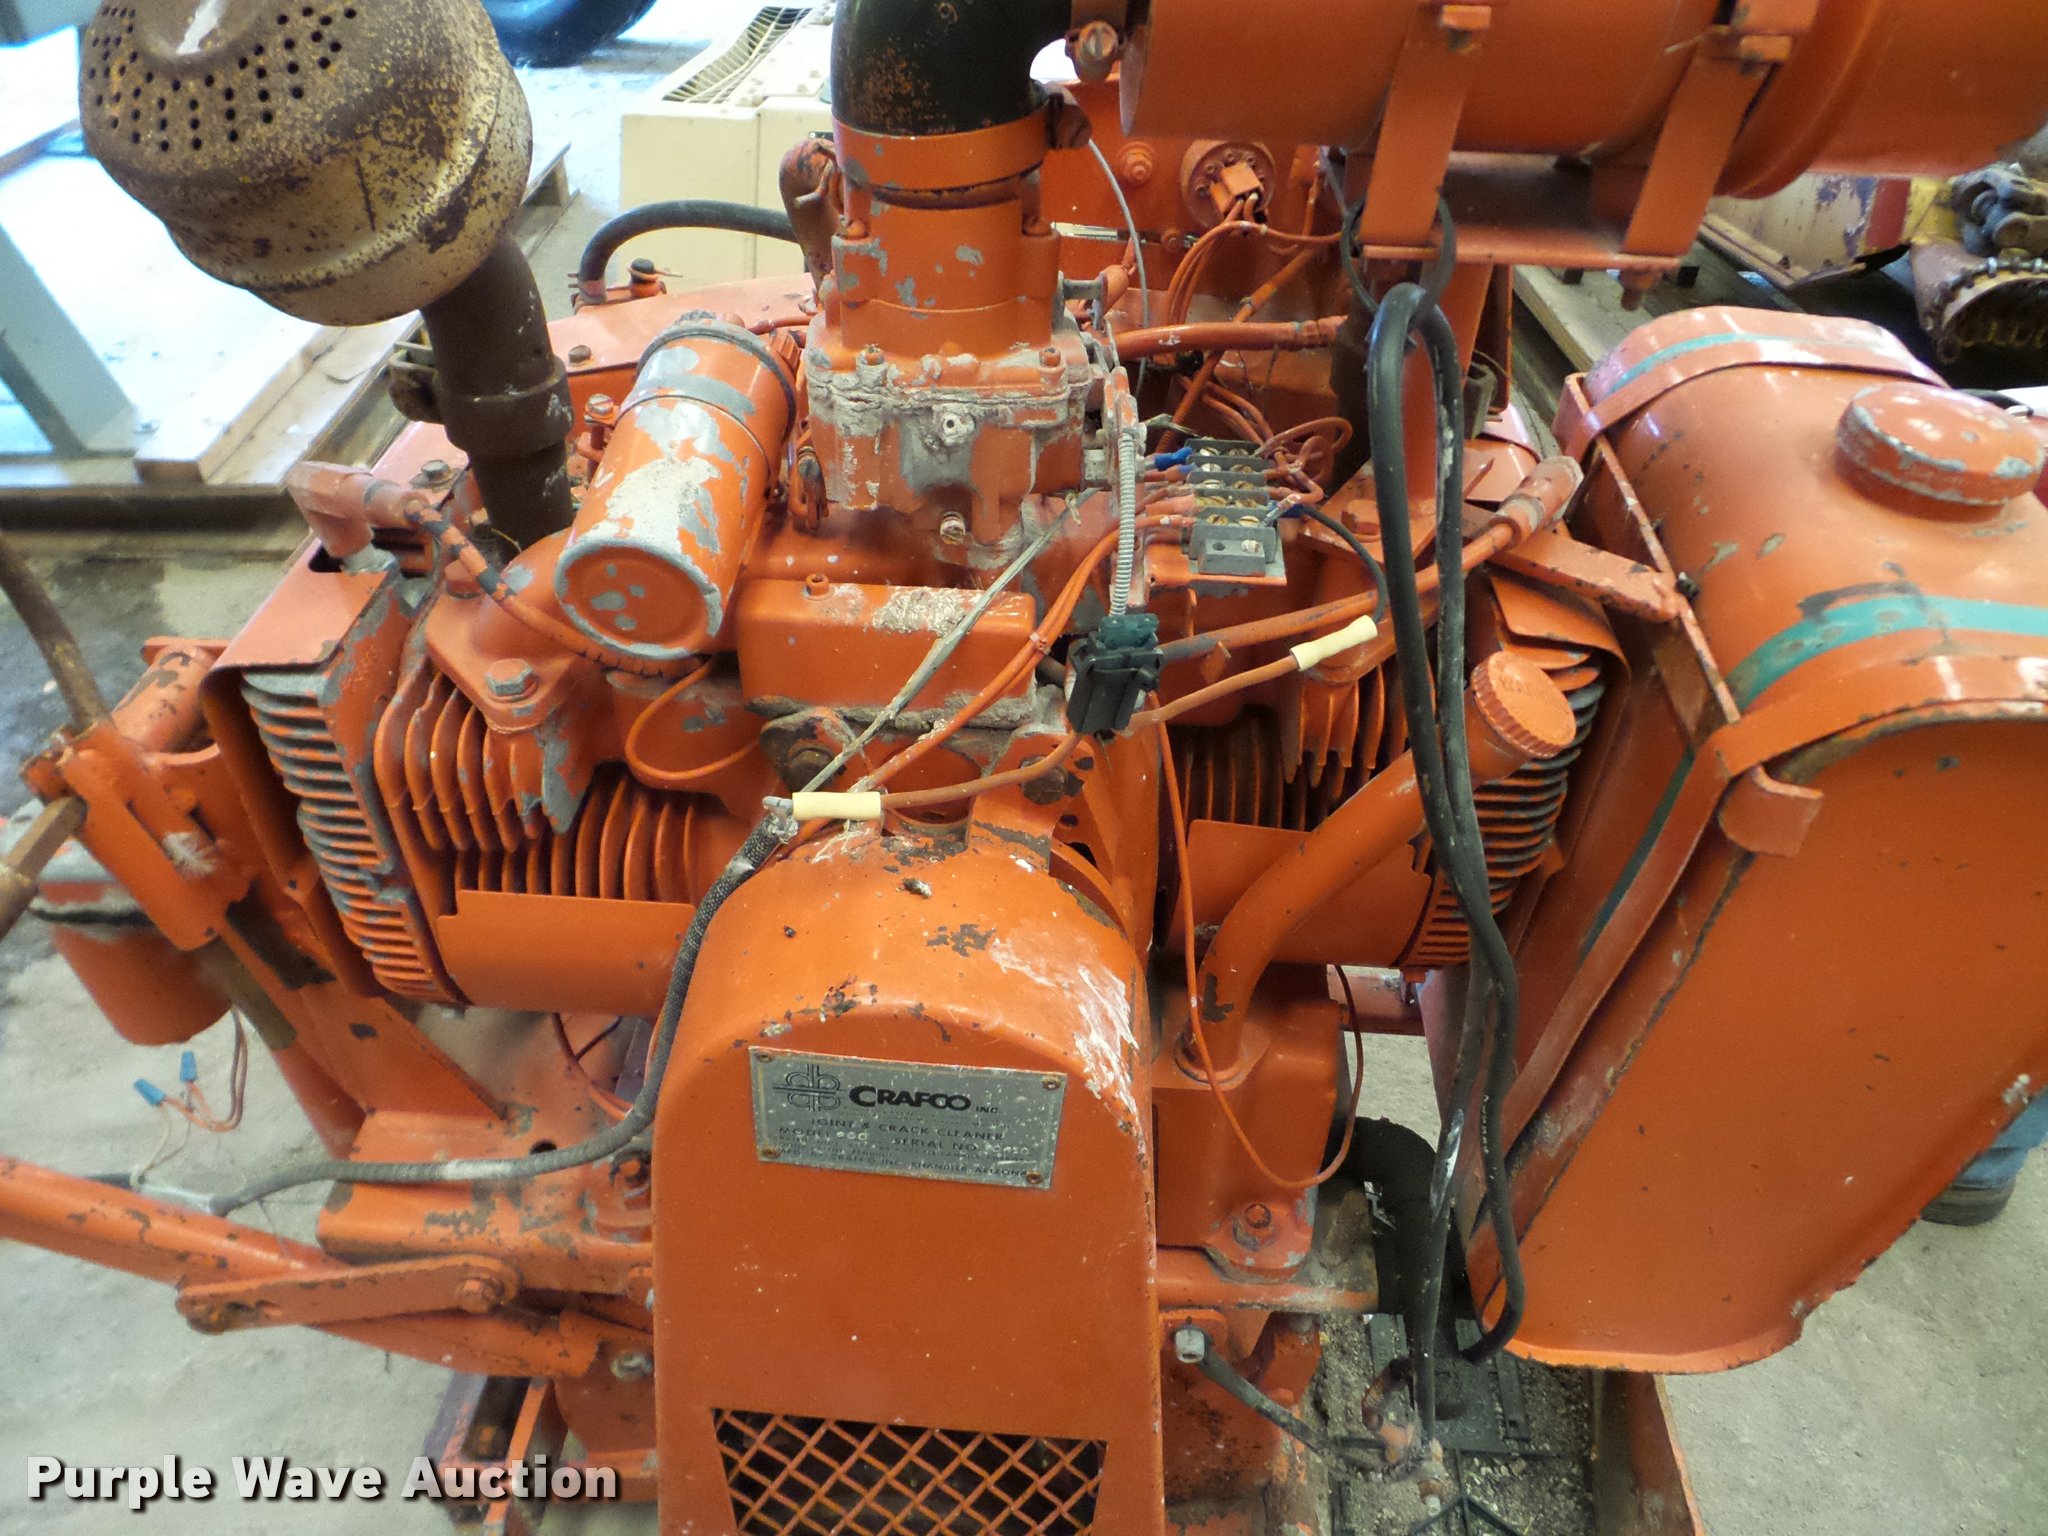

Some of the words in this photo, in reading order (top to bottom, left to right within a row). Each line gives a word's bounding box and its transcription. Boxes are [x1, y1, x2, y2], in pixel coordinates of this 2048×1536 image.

[848, 1085, 972, 1111] CRAFCO
[778, 1126, 830, 1138] MODEL
[811, 1118, 854, 1129] JOINT
[878, 1123, 929, 1135] CRACK
[936, 1128, 1004, 1141] CLEANER
[894, 1137, 943, 1149] SERIAL
